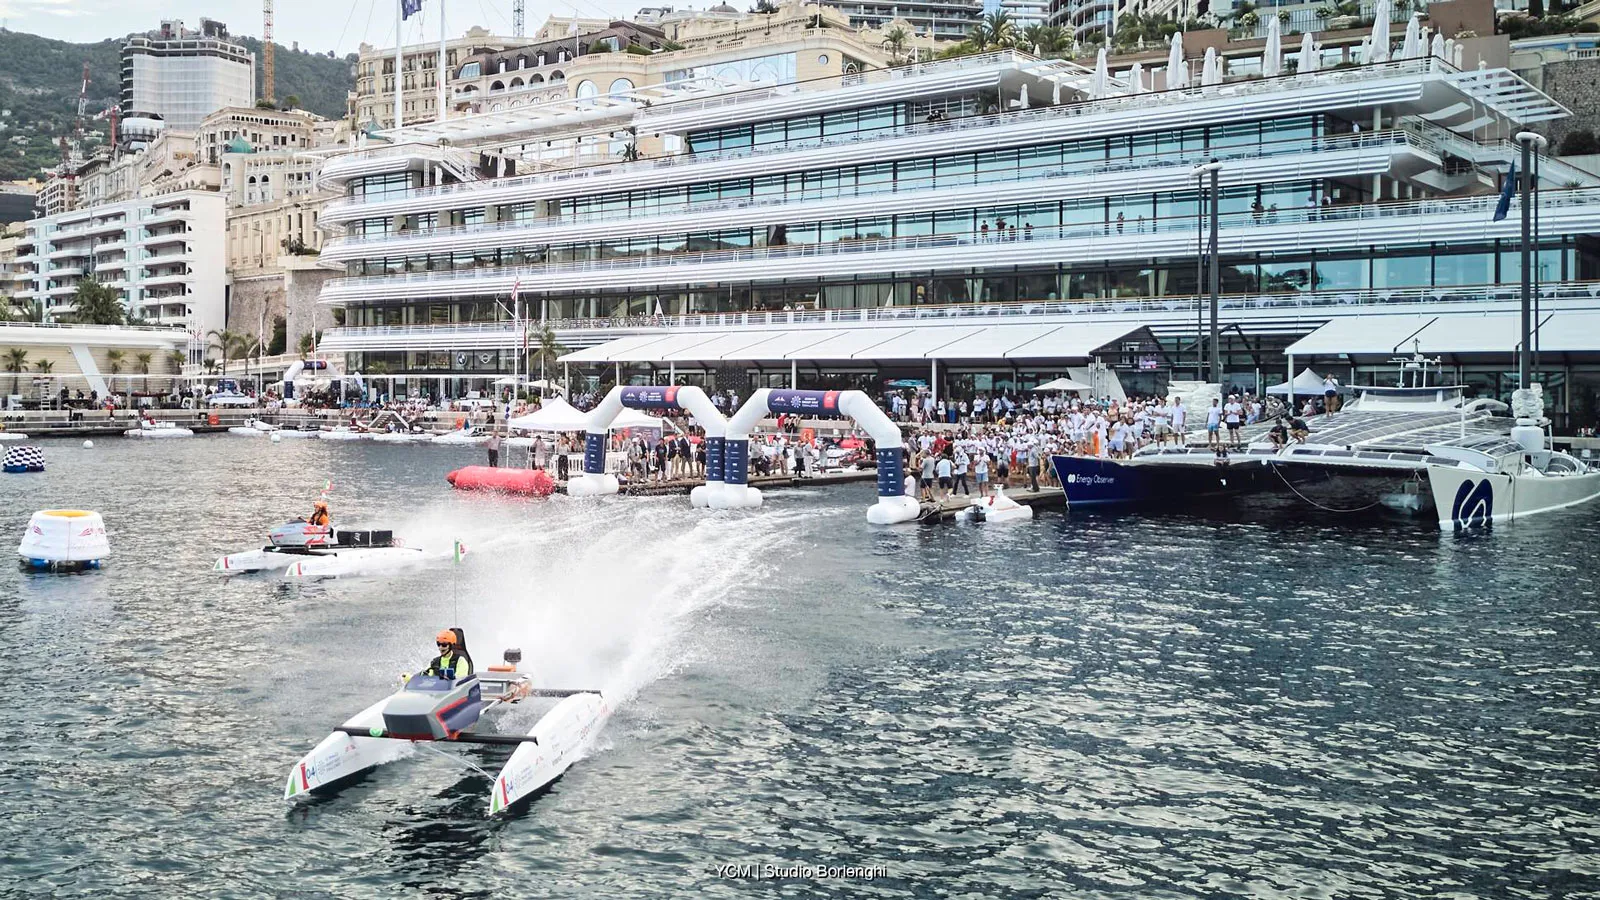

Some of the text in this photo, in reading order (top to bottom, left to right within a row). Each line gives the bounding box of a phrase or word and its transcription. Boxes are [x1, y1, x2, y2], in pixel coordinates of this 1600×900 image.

[1076, 473, 1115, 486] Energy Observer
[306, 766, 316, 779] 04
